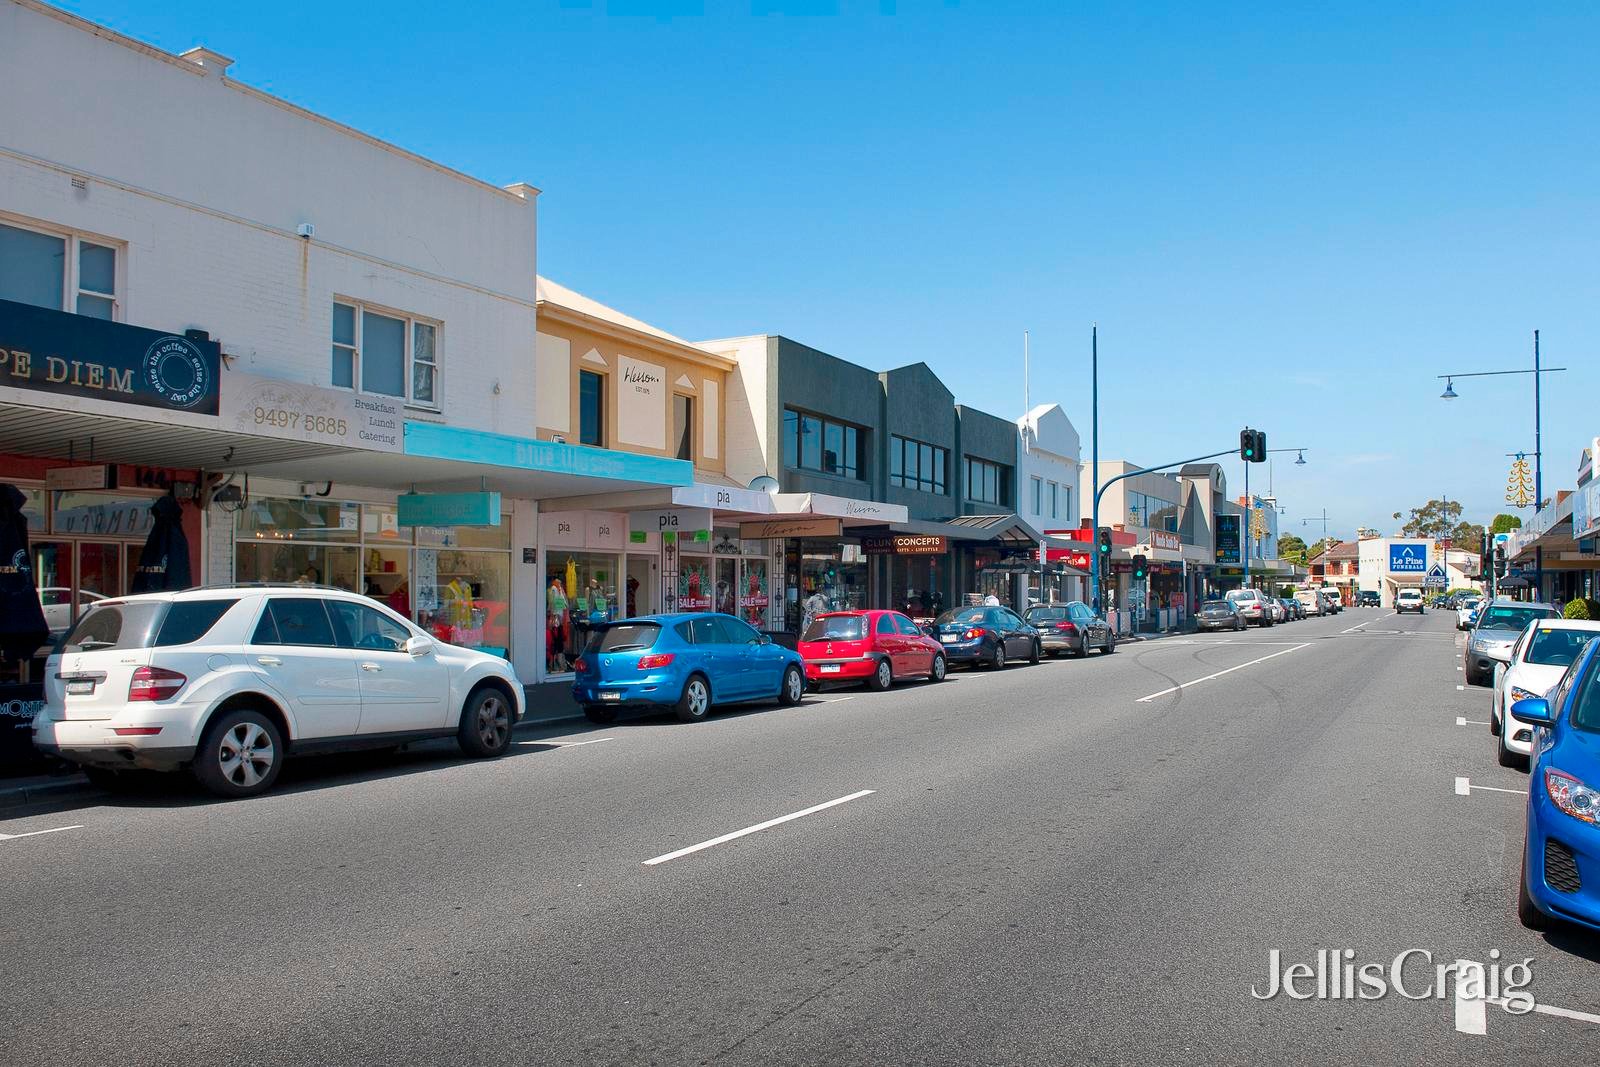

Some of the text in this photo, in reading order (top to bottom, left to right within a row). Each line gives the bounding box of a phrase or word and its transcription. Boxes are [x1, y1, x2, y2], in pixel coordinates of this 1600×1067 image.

[45, 356, 136, 394] DIEM
[354, 399, 397, 415] Breakfast
[254, 406, 347, 436] 9497 5685
[369, 416, 396, 429] Lunch
[358, 430, 396, 445] Catering
[717, 490, 731, 506] pia
[557, 521, 571, 535] pia
[658, 512, 679, 530] pia
[598, 524, 610, 535] pia
[897, 537, 940, 546] CONCEPTS
[1392, 556, 1423, 565] Le Pine
[679, 598, 695, 608] SALE
[740, 597, 755, 607] SALE
